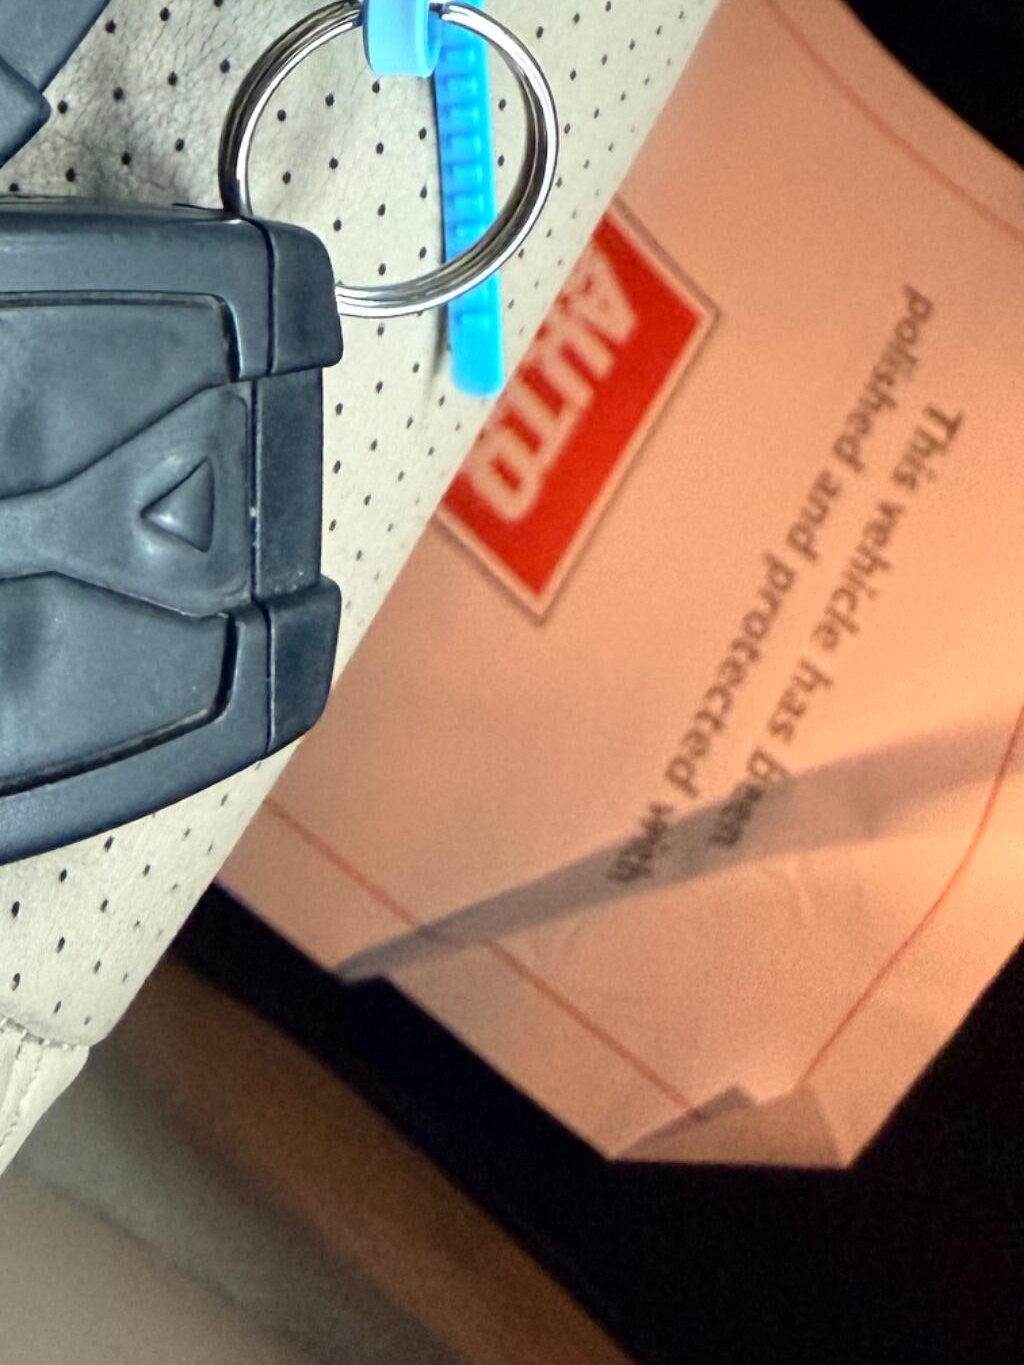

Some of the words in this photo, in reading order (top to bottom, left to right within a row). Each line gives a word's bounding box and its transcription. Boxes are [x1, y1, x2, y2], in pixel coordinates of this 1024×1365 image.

[470, 239, 638, 524] AUTO
[832, 283, 935, 474] polished
[892, 402, 965, 491] This
[786, 467, 843, 563] and
[810, 500, 905, 653] vehicle
[664, 549, 796, 799] protected
[766, 655, 834, 741] has
